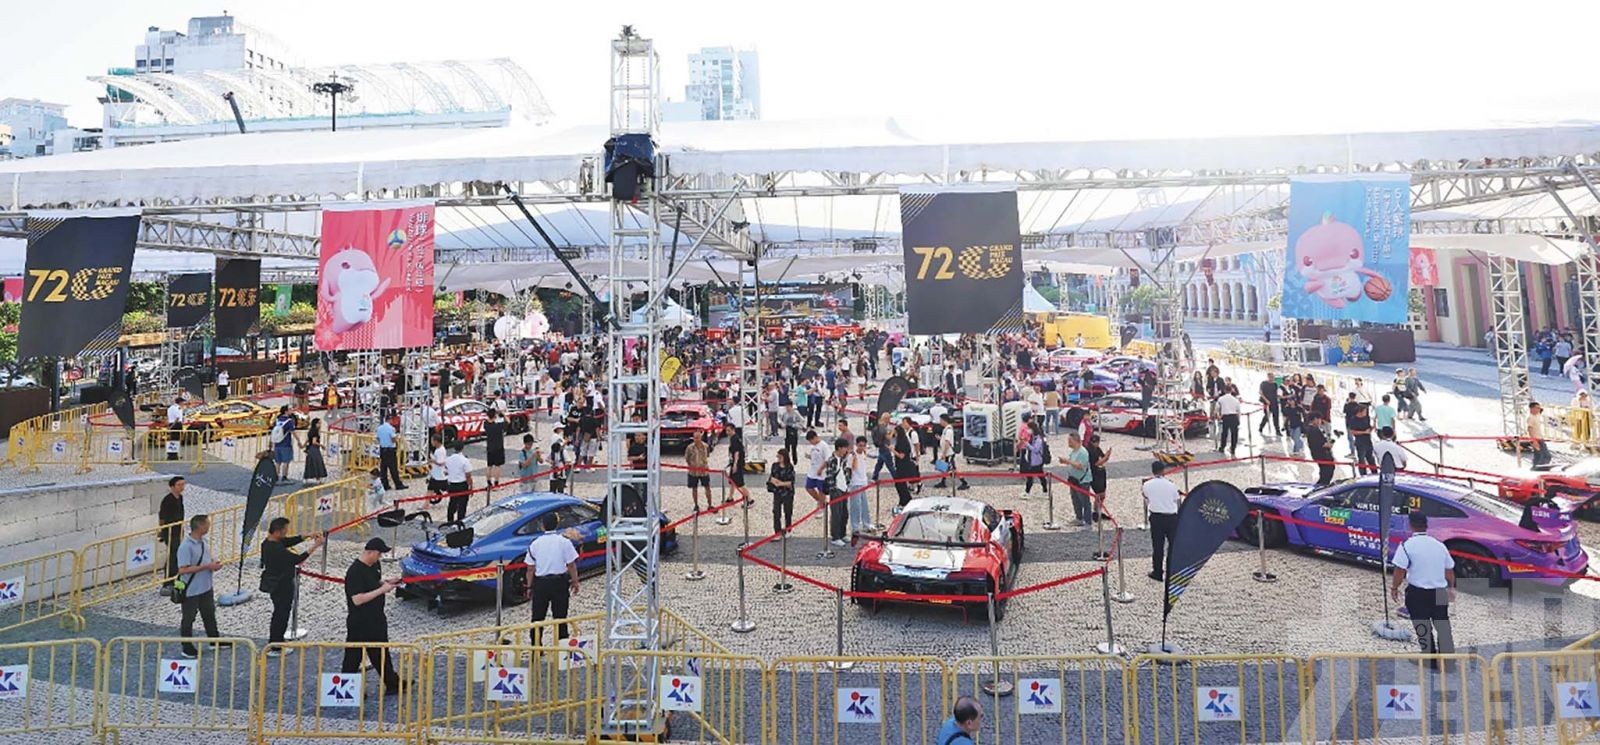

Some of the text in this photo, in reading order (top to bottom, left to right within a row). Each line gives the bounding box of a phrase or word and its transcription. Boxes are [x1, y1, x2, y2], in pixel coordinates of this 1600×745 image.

[912, 247, 955, 280] 72
[27, 269, 70, 302] 72
[170, 293, 186, 307] 72
[218, 287, 237, 307] 72
[1409, 496, 1421, 508] 31
[912, 549, 932, 560] 45
